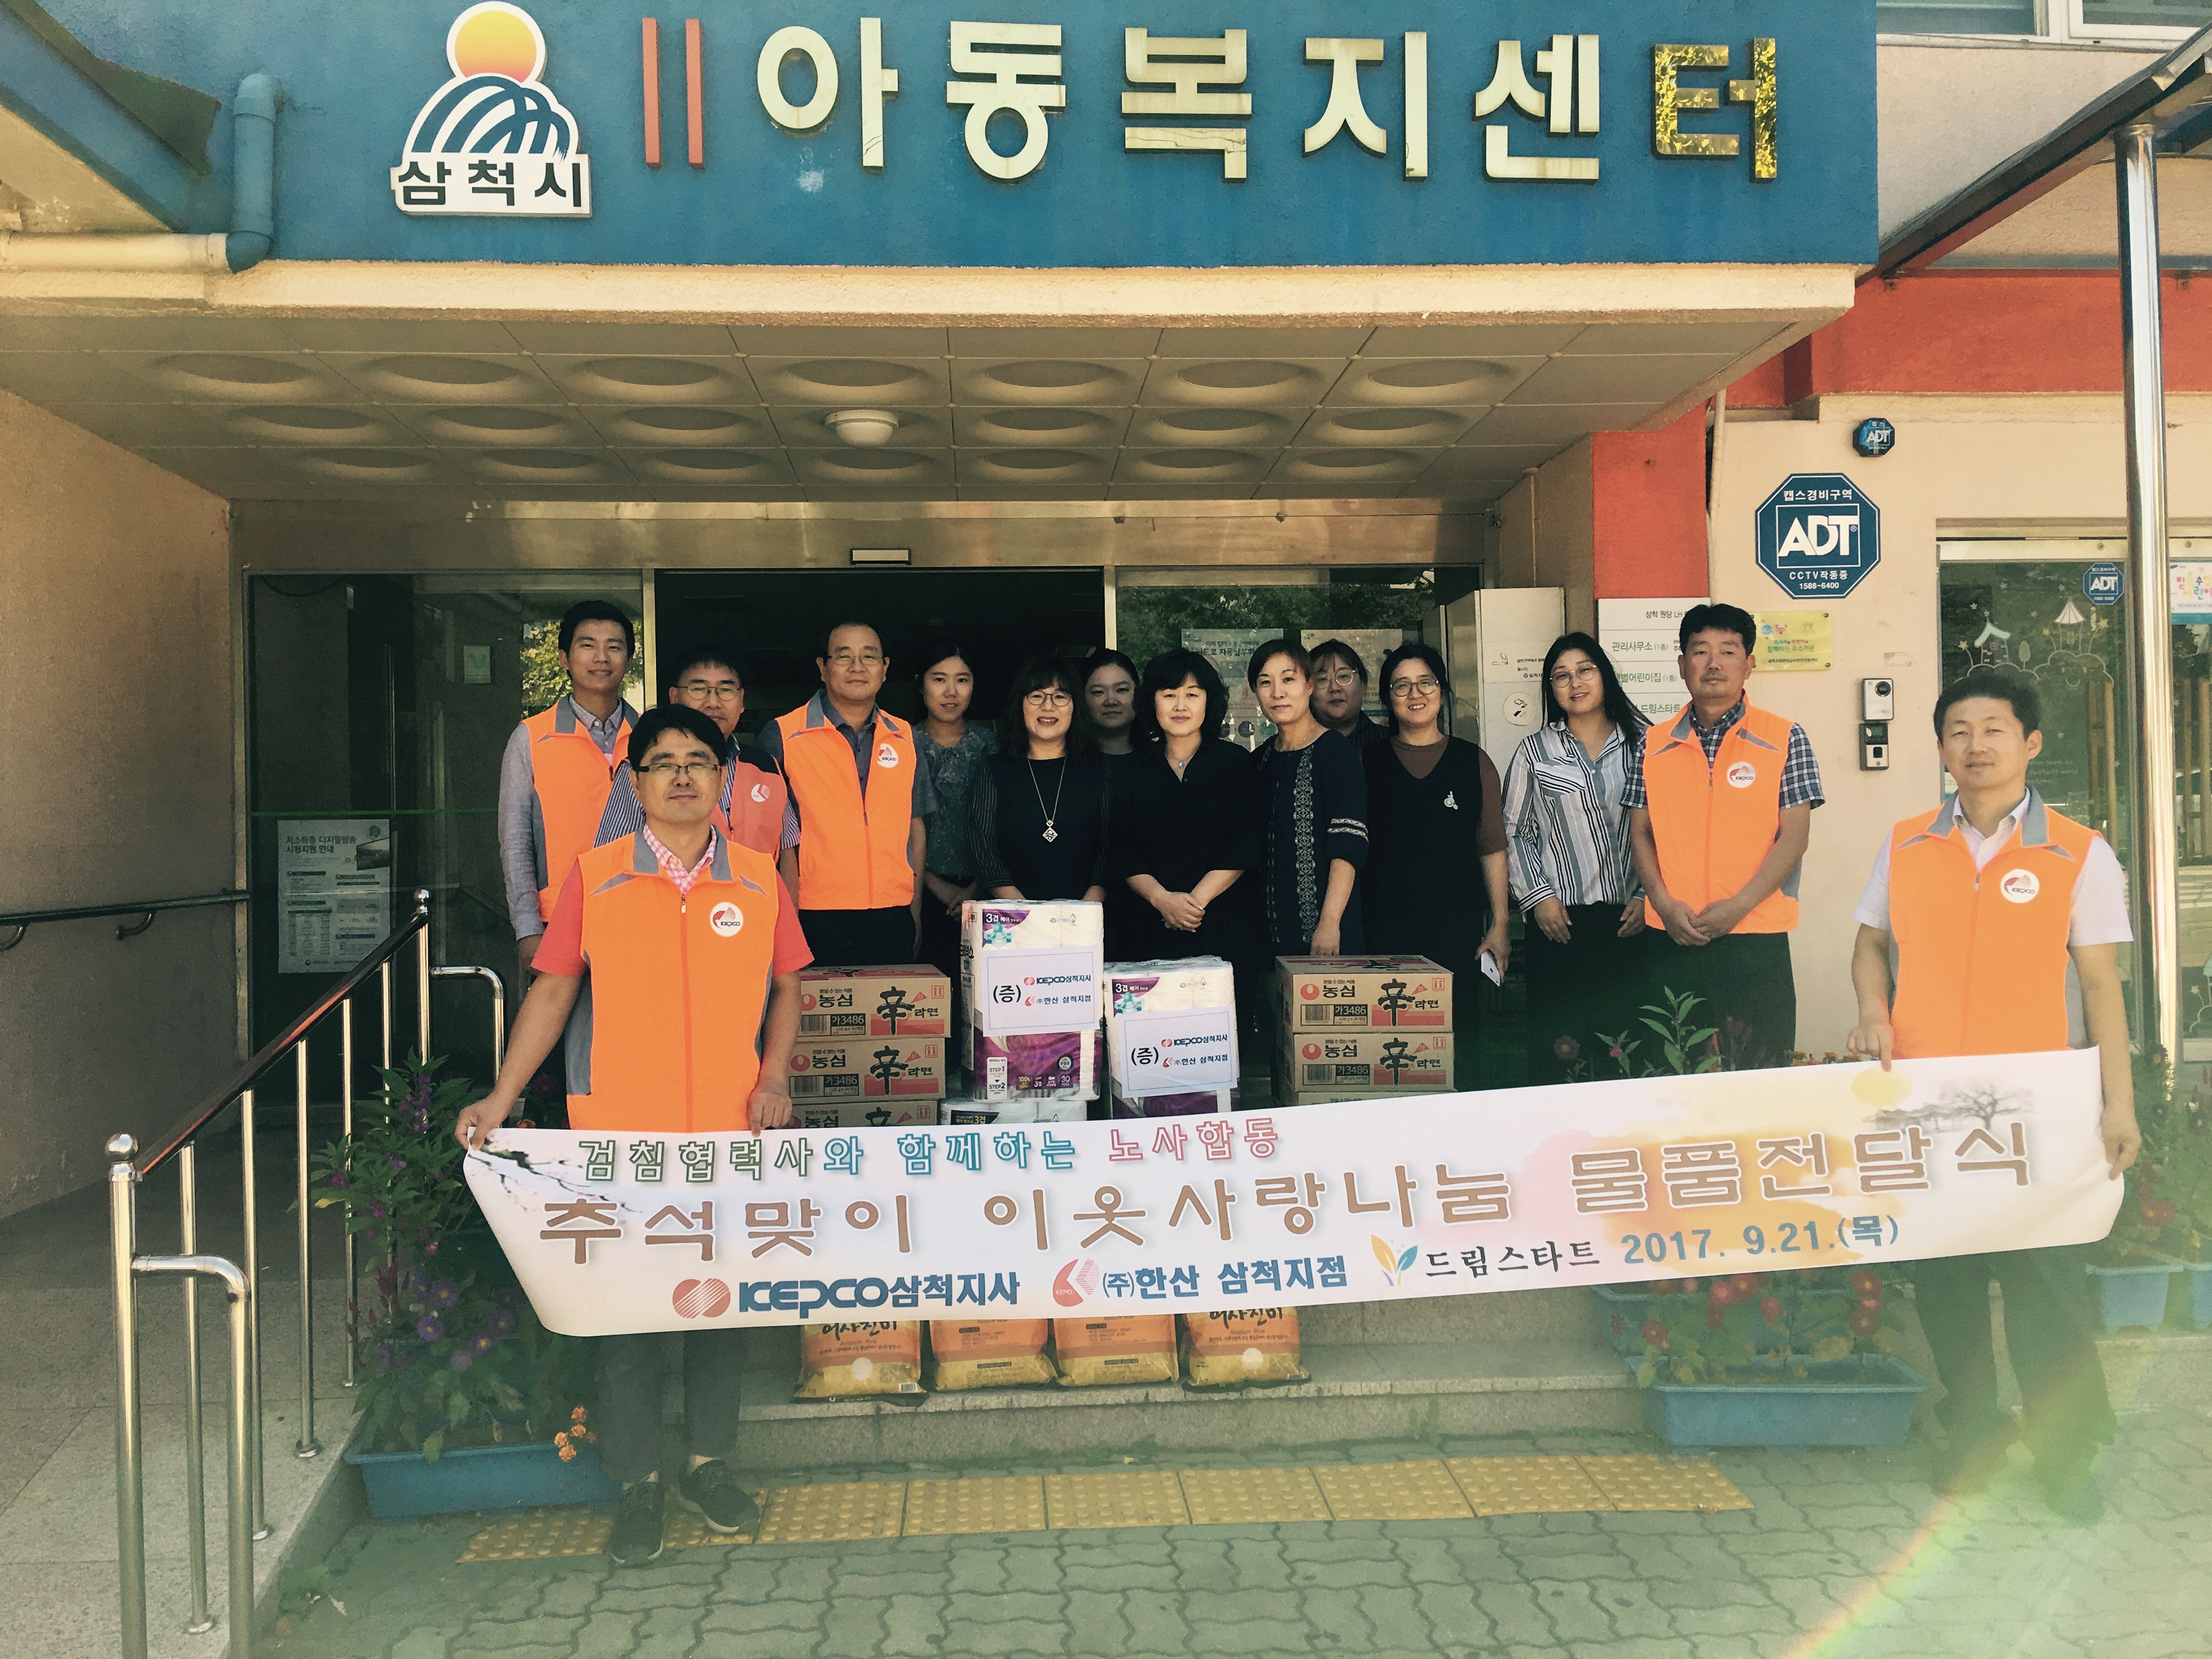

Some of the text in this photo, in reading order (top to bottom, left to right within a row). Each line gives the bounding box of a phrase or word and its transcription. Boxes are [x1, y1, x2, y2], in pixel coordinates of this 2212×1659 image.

[757, 16, 1777, 179] 아동복지센터
[398, 160, 583, 207] 삼척시
[1866, 430, 1891, 443] ADT
[1784, 489, 1852, 501] 캡스경비구역
[1778, 515, 1859, 557] ADT
[2090, 577, 2118, 590] ADT
[1612, 641, 1653, 652] 관리사무소
[319, 845, 334, 854] 안내
[986, 913, 998, 923] 3겹
[993, 985, 1021, 1003] (증)
[1115, 983, 1128, 993] 3겹
[1323, 985, 1355, 998] 농심
[819, 994, 853, 1008] 농심
[1378, 978, 1439, 1026] 辛 라면
[877, 986, 939, 1035] 辛 라면
[1335, 1006, 1366, 1015] 가3486
[832, 1015, 864, 1025] 가3486
[1131, 1047, 1159, 1066] (증)
[1324, 1045, 1357, 1058] 농심
[812, 1054, 846, 1069] 농심
[1380, 1037, 1441, 1086] 辛 라면
[870, 1045, 933, 1096] 辛 라면
[1338, 1065, 1368, 1075] 가3486
[825, 1076, 857, 1086] 가3486
[804, 1115, 839, 1128] 농심
[578, 1117, 1279, 1183] 검침협력사와 함께하는 노사합동
[540, 1122, 2032, 1265] 추석맞이 이웃사랑나눔 물품전달식
[1621, 1228, 1724, 1265] 2017.
[1426, 1240, 1600, 1278] 드림스타트
[1102, 1254, 1348, 1300] (주)한산 삼척지점
